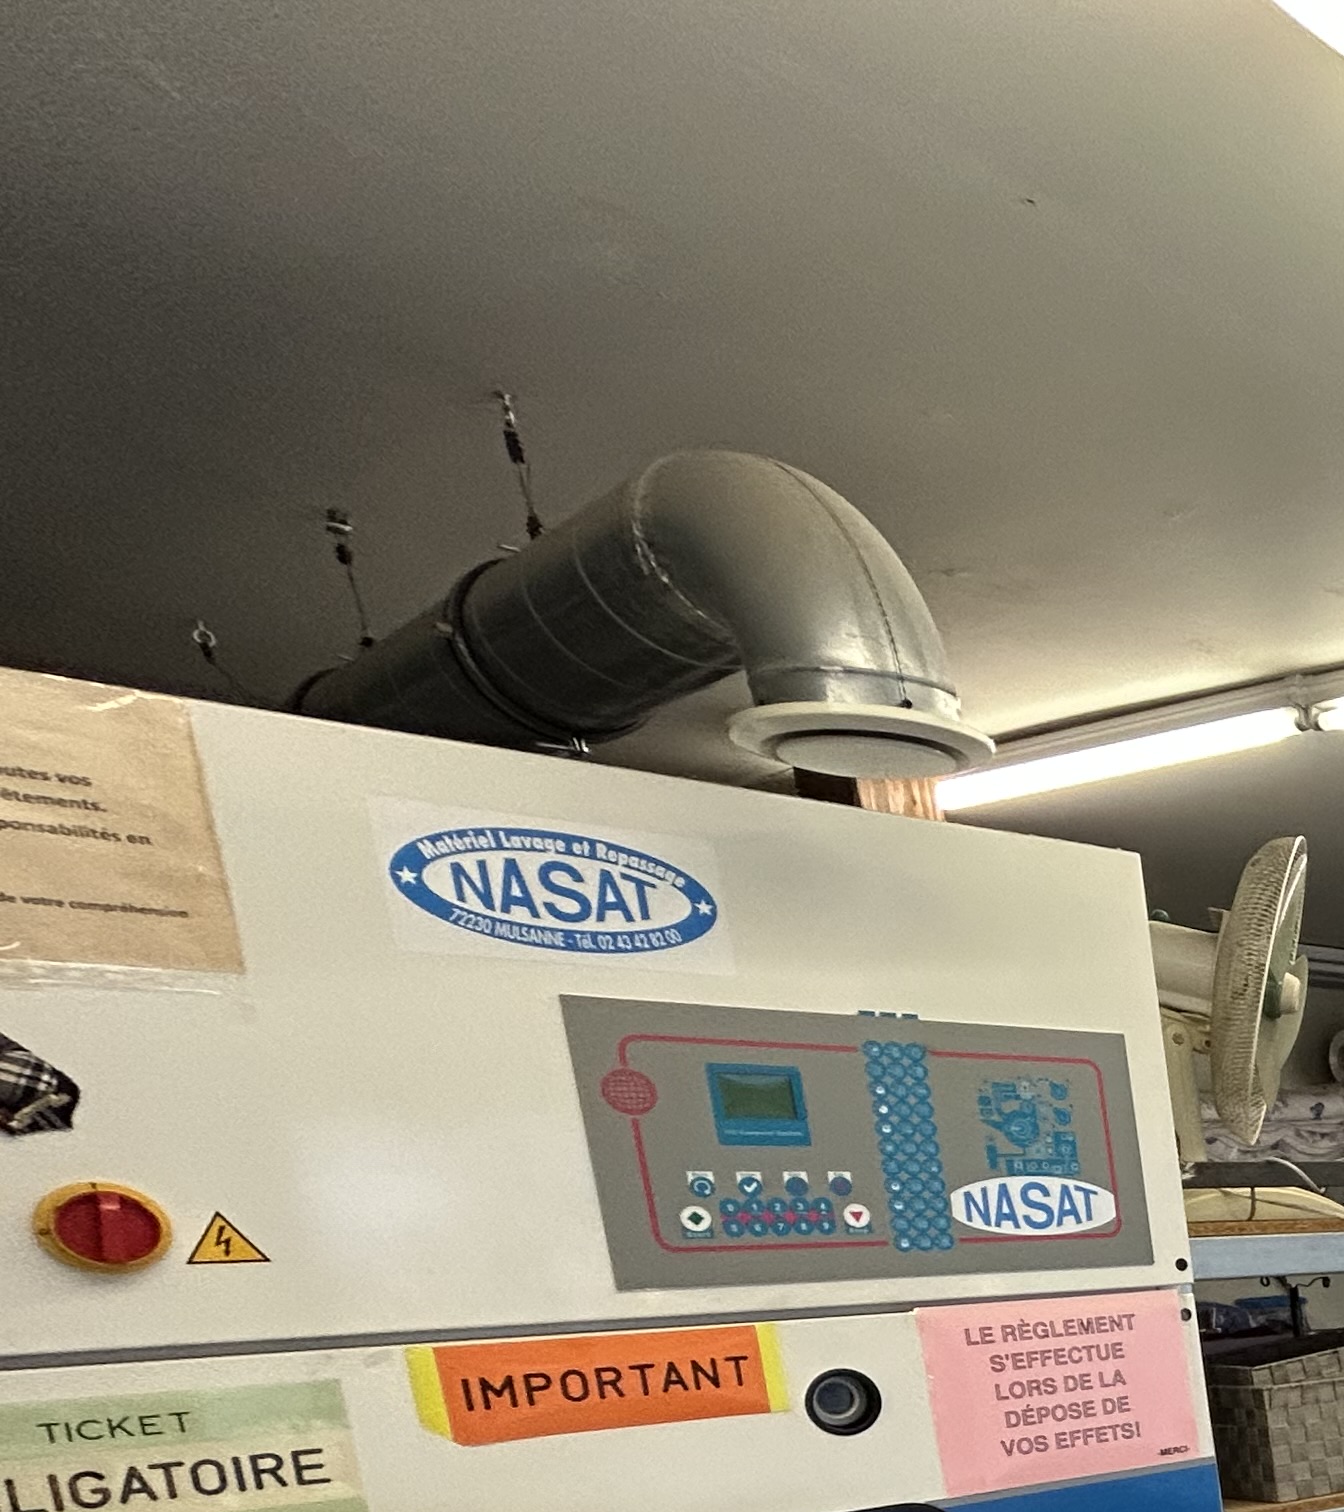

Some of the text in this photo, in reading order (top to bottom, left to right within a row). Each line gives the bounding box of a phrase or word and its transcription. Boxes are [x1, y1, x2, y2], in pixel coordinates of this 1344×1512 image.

[55, 772, 93, 788] vos
[127, 833, 153, 846] en
[416, 829, 686, 888] Matériel Lavage et Repassage
[449, 857, 658, 923] NASAT
[450, 908, 493, 935] 72230
[494, 921, 565, 948] MULSANNE
[963, 1181, 1098, 1229] NASAT
[964, 1313, 1136, 1346] LE RÈGLEMENT
[989, 1341, 1126, 1373] S'EFFECTUE
[460, 1355, 748, 1411] IMPORTANT
[994, 1369, 1127, 1401] LORS DE LA
[36, 1411, 191, 1443] TICKET
[1004, 1395, 1131, 1429] DÉPOSE DE
[1000, 1421, 1141, 1457] VOS EFFETS!
